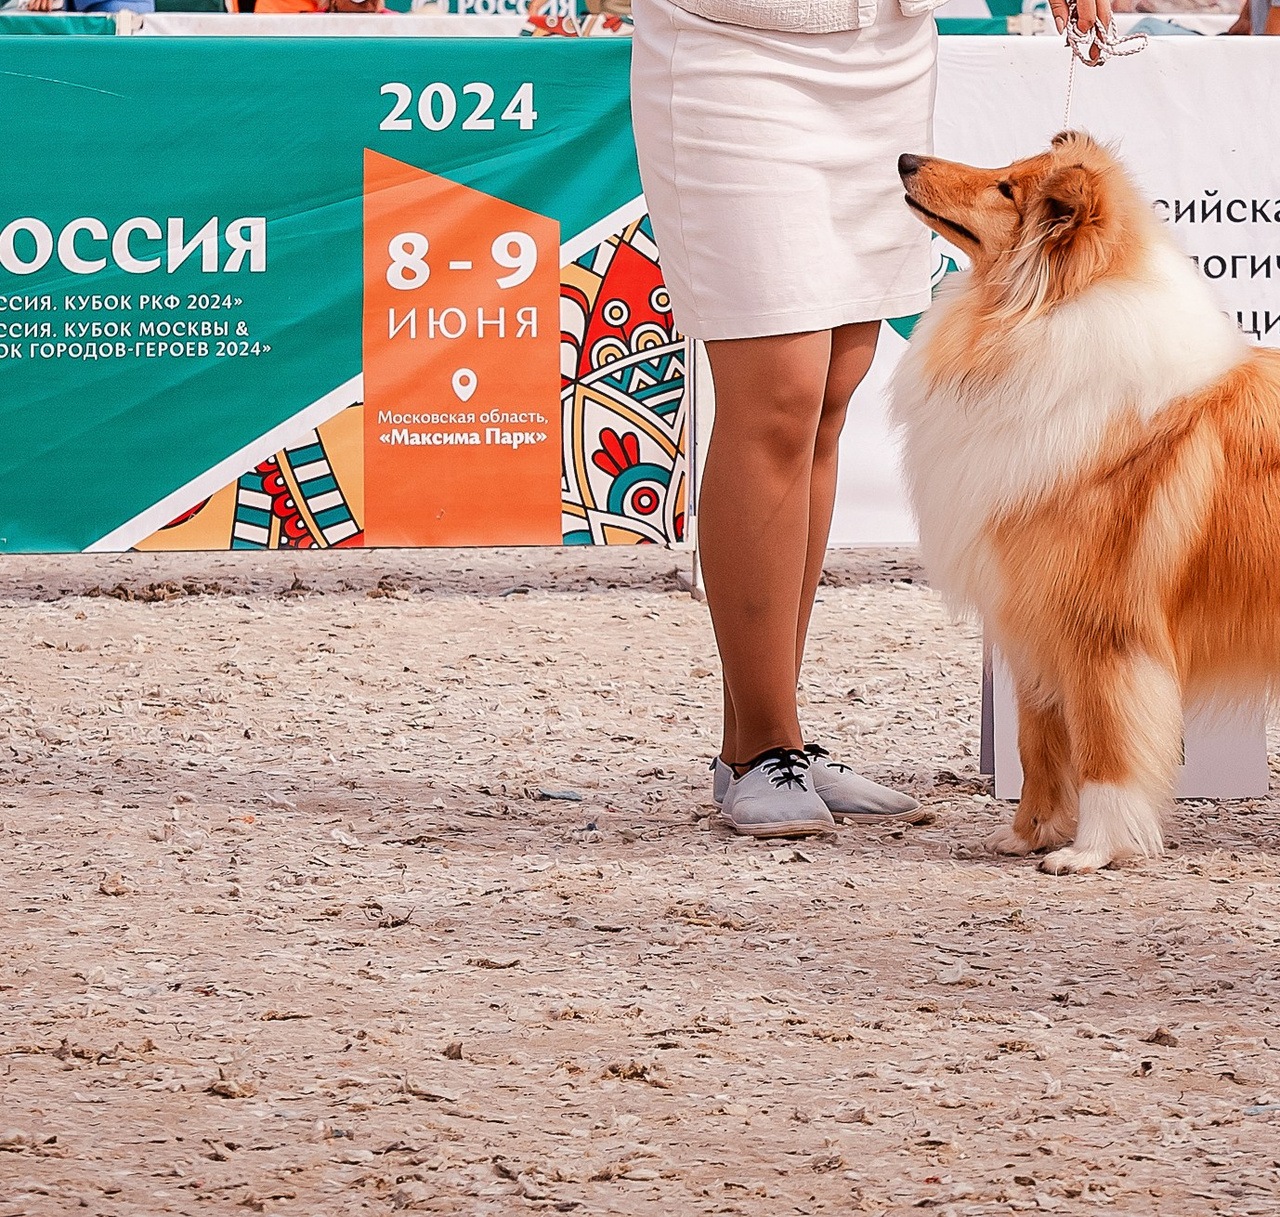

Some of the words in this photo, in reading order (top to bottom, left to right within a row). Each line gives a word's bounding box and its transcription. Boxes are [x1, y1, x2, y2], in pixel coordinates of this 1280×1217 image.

[379, 82, 538, 131] 2024
[386, 232, 431, 290] 8
[491, 231, 538, 289] 9
[64, 295, 133, 310] КУБОК
[139, 294, 181, 310] РКФ
[186, 294, 244, 310] 2024»
[64, 322, 132, 337] КУБОК
[139, 321, 229, 337] МОСКВЫ
[235, 321, 249, 336] &
[388, 306, 538, 339] ИЮНЯ
[30, 342, 209, 360] ГОРОДОВ-ГЕРОЕВ
[215, 341, 272, 357] 2024»
[377, 410, 475, 425] Московская
[479, 409, 549, 424] область,
[379, 428, 481, 446] «Максима
[485, 427, 548, 450] Парк»
